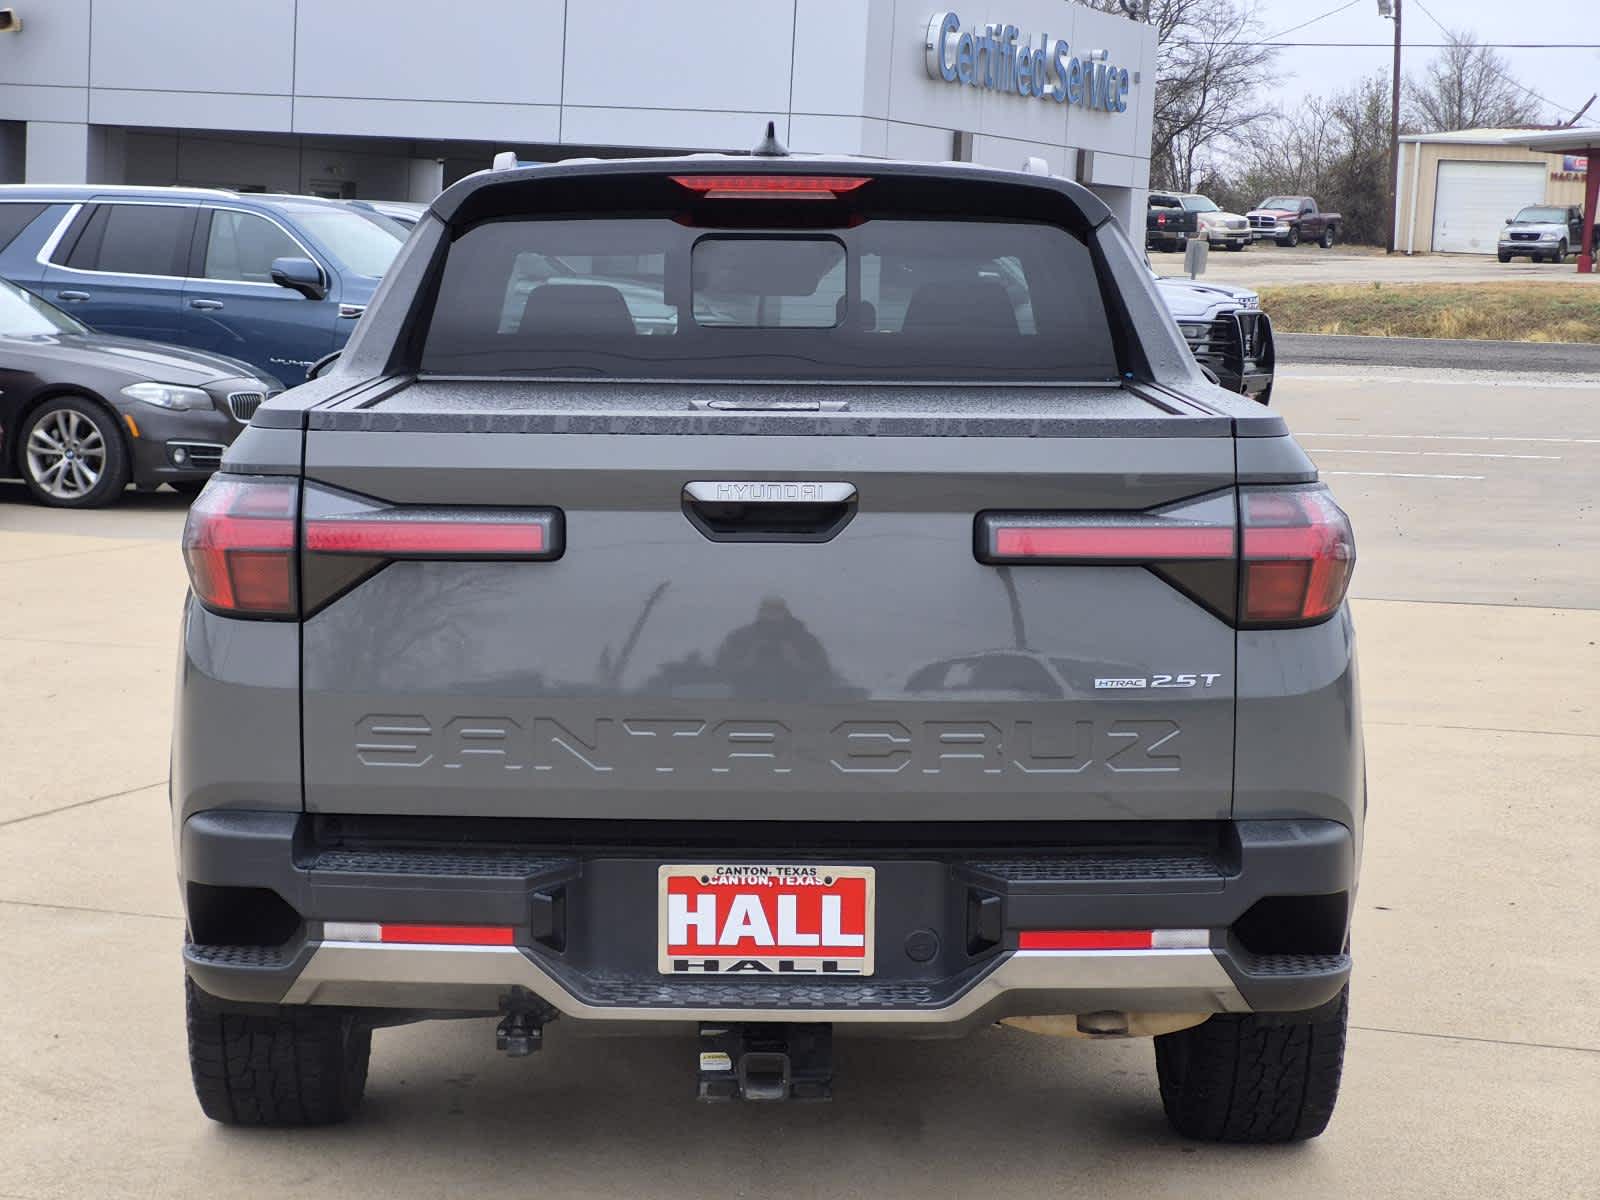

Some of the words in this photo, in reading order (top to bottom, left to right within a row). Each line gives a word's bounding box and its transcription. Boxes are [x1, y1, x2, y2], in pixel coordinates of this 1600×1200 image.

[933, 12, 1048, 97] Certified
[1049, 39, 1129, 113] Service
[716, 484, 823, 500] HYUNDAI
[1097, 679, 1145, 688] HTRAC
[354, 713, 792, 773] SANTA
[829, 719, 1181, 773] CRUZ
[776, 867, 817, 876] TEXAS
[709, 875, 773, 887] CANTON,
[778, 876, 824, 886] TEXAS
[667, 894, 865, 947] HALL
[673, 959, 861, 973] HALL
